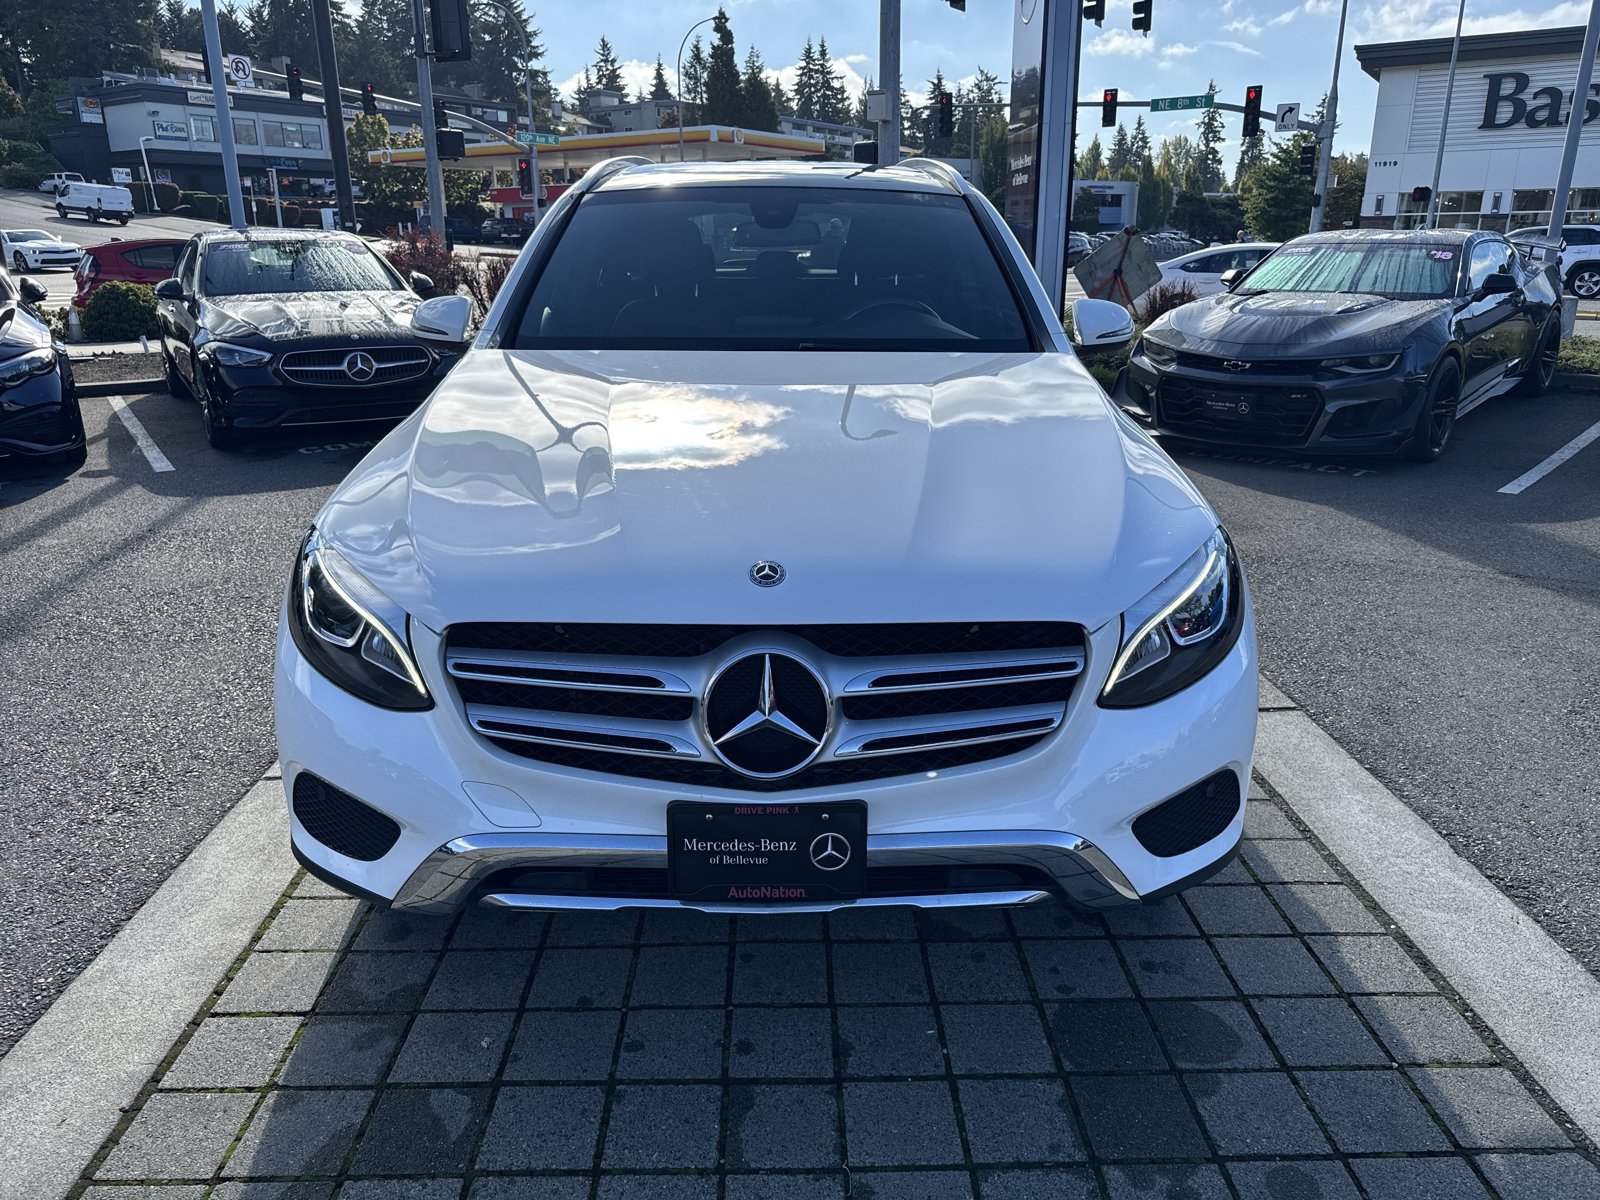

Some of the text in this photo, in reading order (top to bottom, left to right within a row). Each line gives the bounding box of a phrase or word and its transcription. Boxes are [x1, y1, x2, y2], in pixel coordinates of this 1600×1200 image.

[1158, 96, 1206, 110] NE 8th St
[520, 134, 556, 144] 120th Ave NE
[1374, 160, 1398, 168] 11919
[734, 806, 790, 815] DRIVE PINK
[683, 838, 798, 852] Mercedes-Benz
[709, 854, 769, 866] of Bellevue
[727, 886, 806, 899] AutoNation
